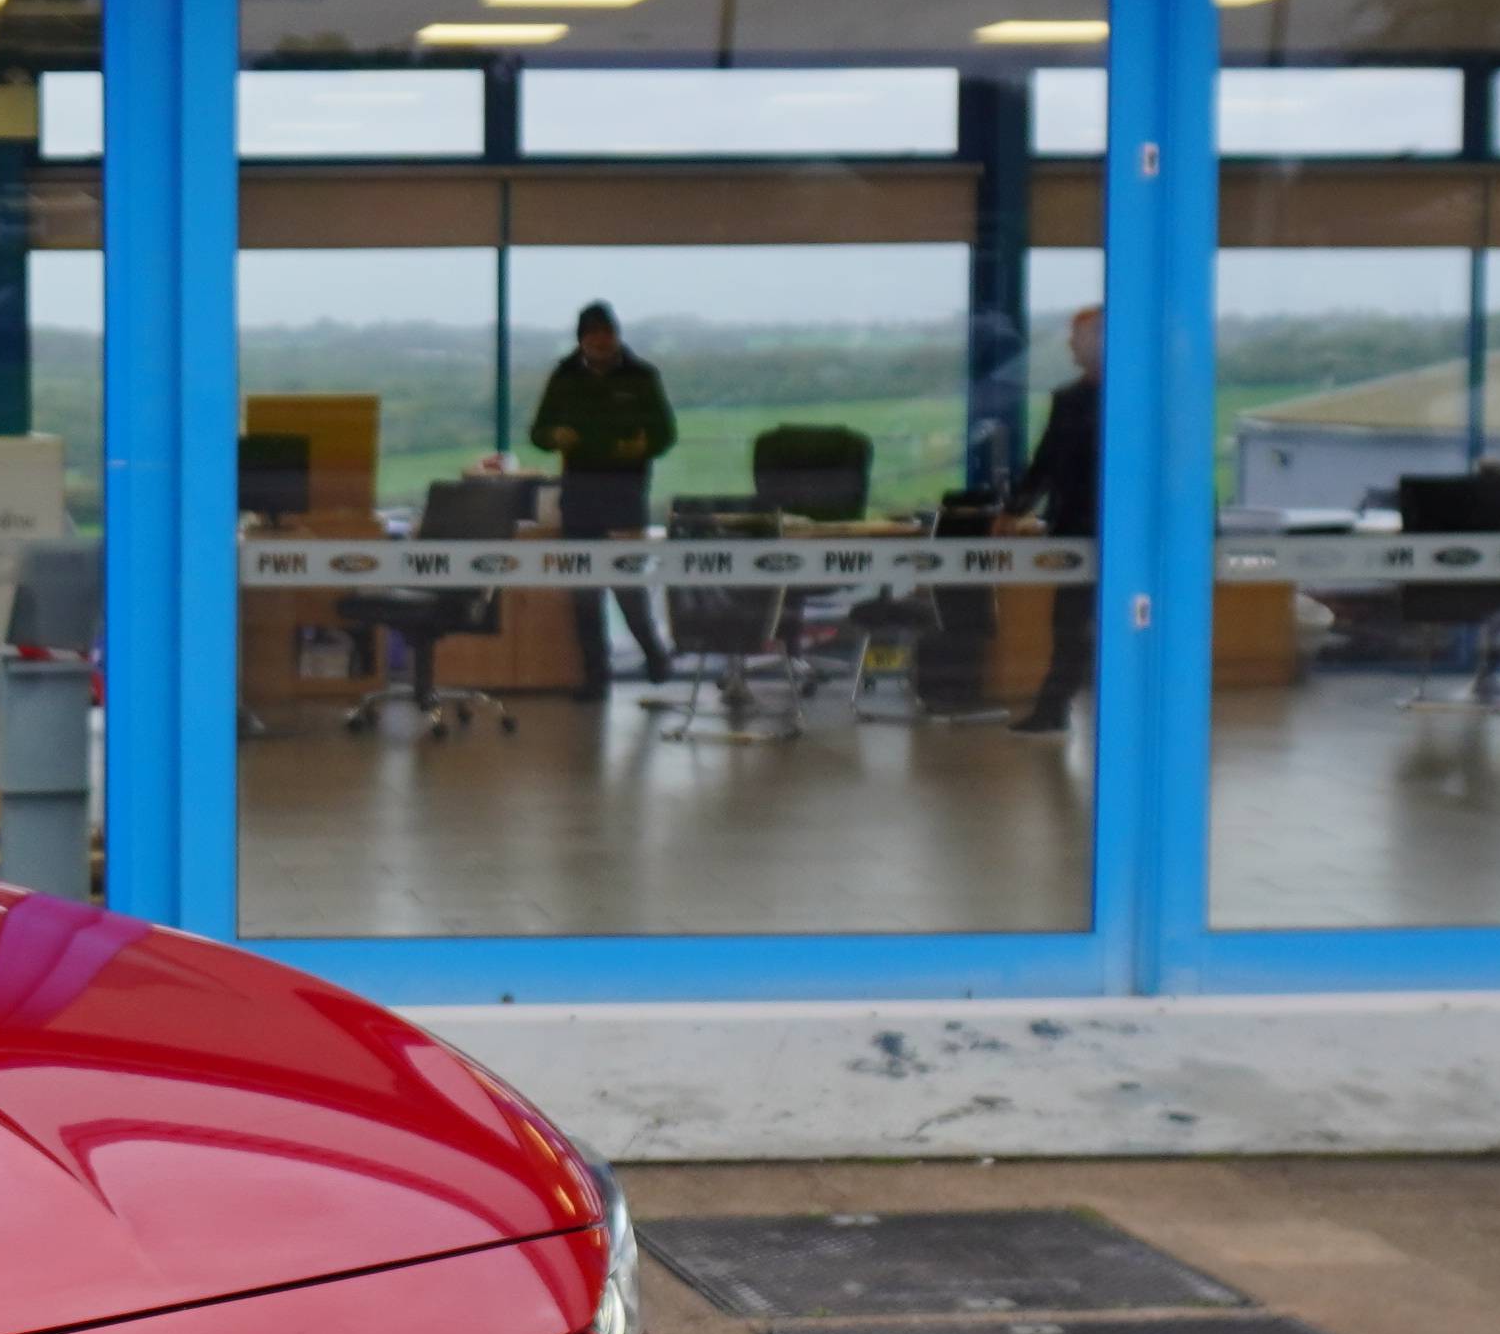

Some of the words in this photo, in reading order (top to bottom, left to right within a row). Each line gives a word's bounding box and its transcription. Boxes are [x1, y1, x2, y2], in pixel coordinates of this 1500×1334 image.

[258, 551, 308, 574] PWM
[542, 551, 592, 574] PWM
[683, 551, 733, 574] PWM
[824, 550, 872, 573] PWM
[964, 549, 1014, 571] PWM
